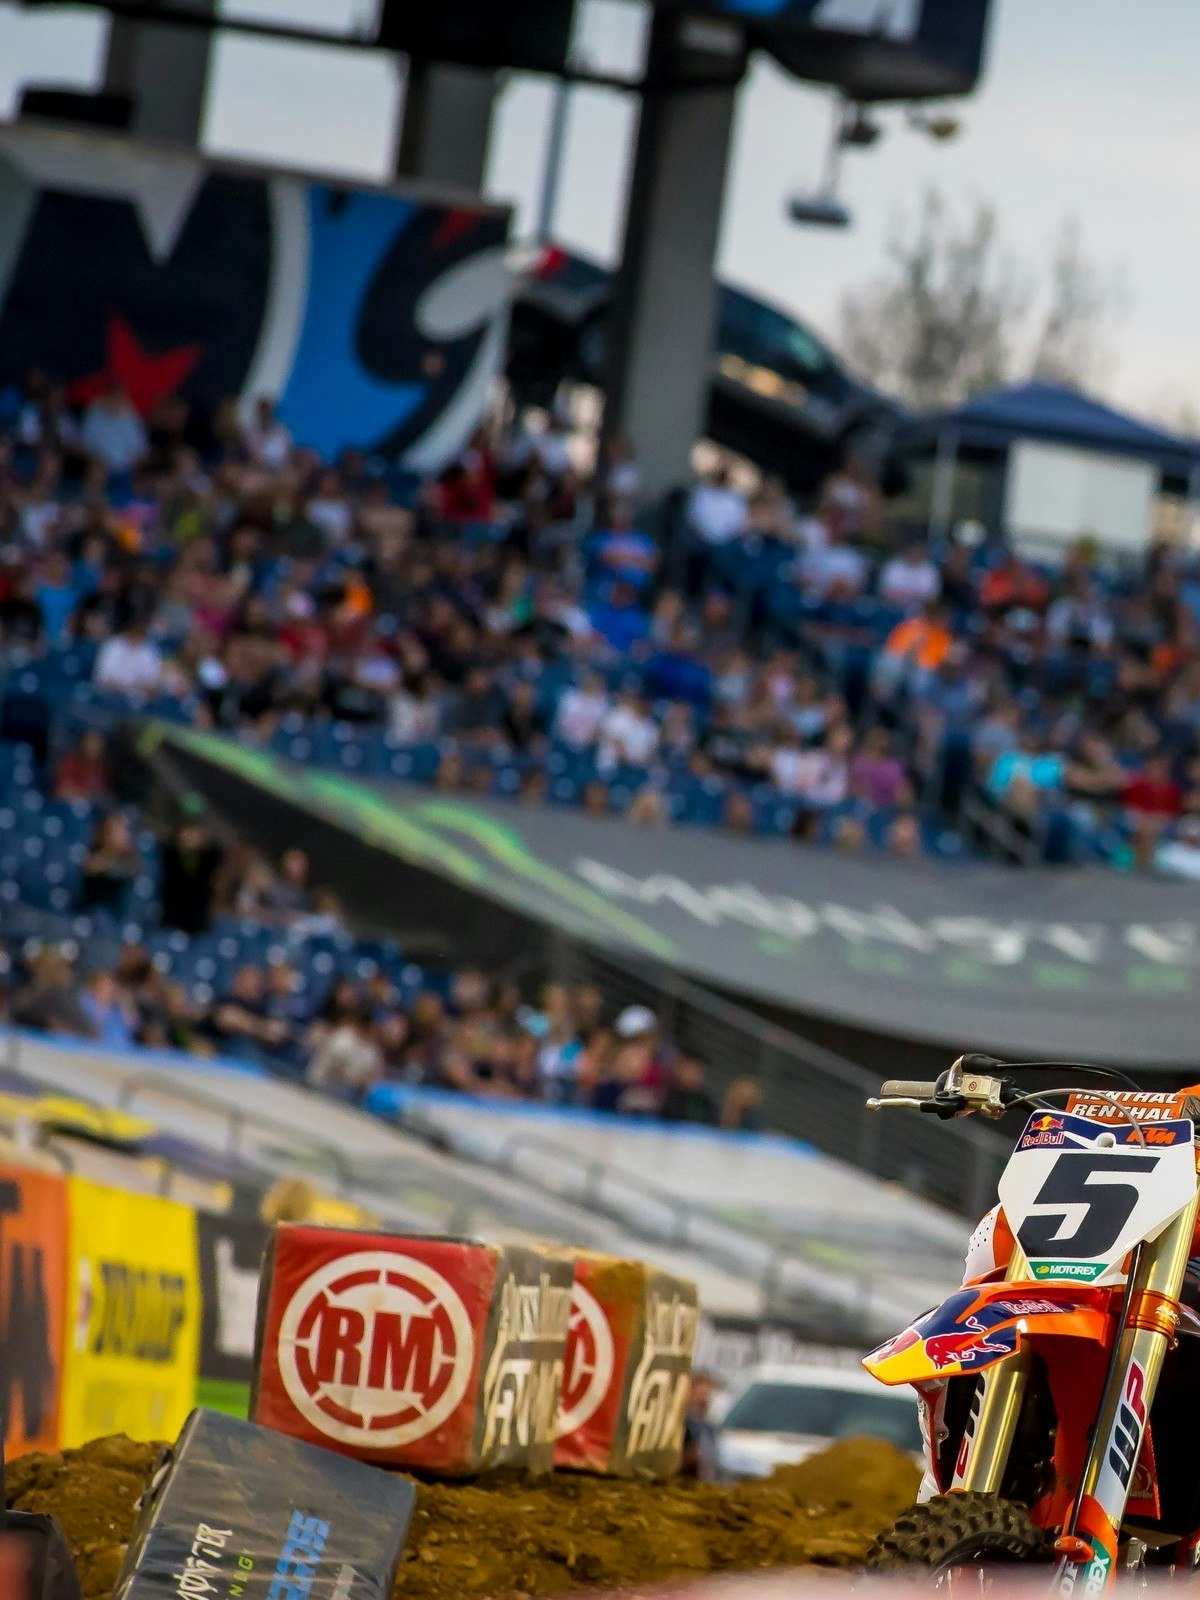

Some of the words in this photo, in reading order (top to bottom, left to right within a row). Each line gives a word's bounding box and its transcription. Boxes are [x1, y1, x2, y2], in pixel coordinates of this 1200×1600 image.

[1070, 1103, 1174, 1120] RENTHAL
[1022, 1131, 1043, 1147] Red
[1041, 1130, 1066, 1146] Bull
[1126, 1127, 1177, 1144] KTM
[1017, 1153, 1161, 1259] 5
[1049, 1264, 1097, 1276] MOTOREX
[314, 1304, 437, 1395] RM
